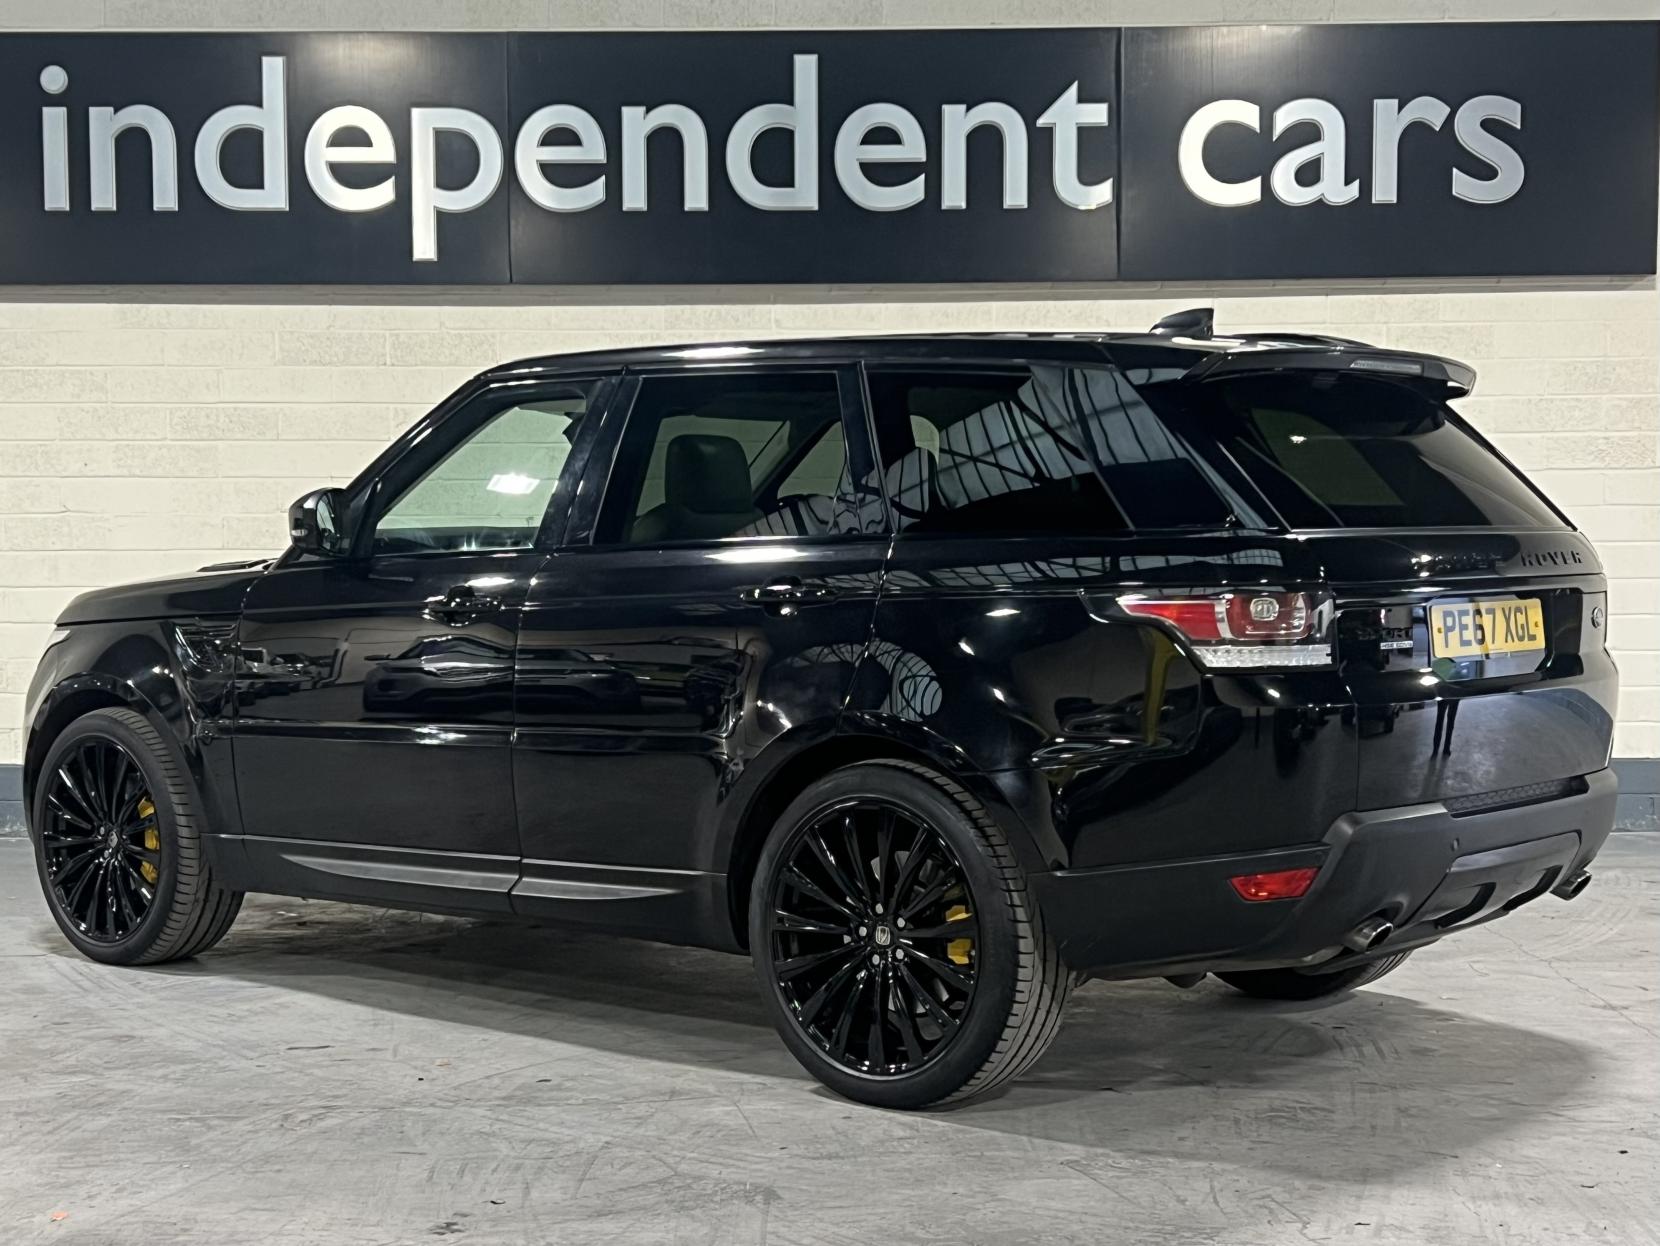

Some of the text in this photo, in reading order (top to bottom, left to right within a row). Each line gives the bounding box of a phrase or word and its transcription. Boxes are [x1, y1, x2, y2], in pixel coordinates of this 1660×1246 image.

[39, 53, 1526, 262] independent cars
[1442, 605, 1537, 649] PE67 XGL
